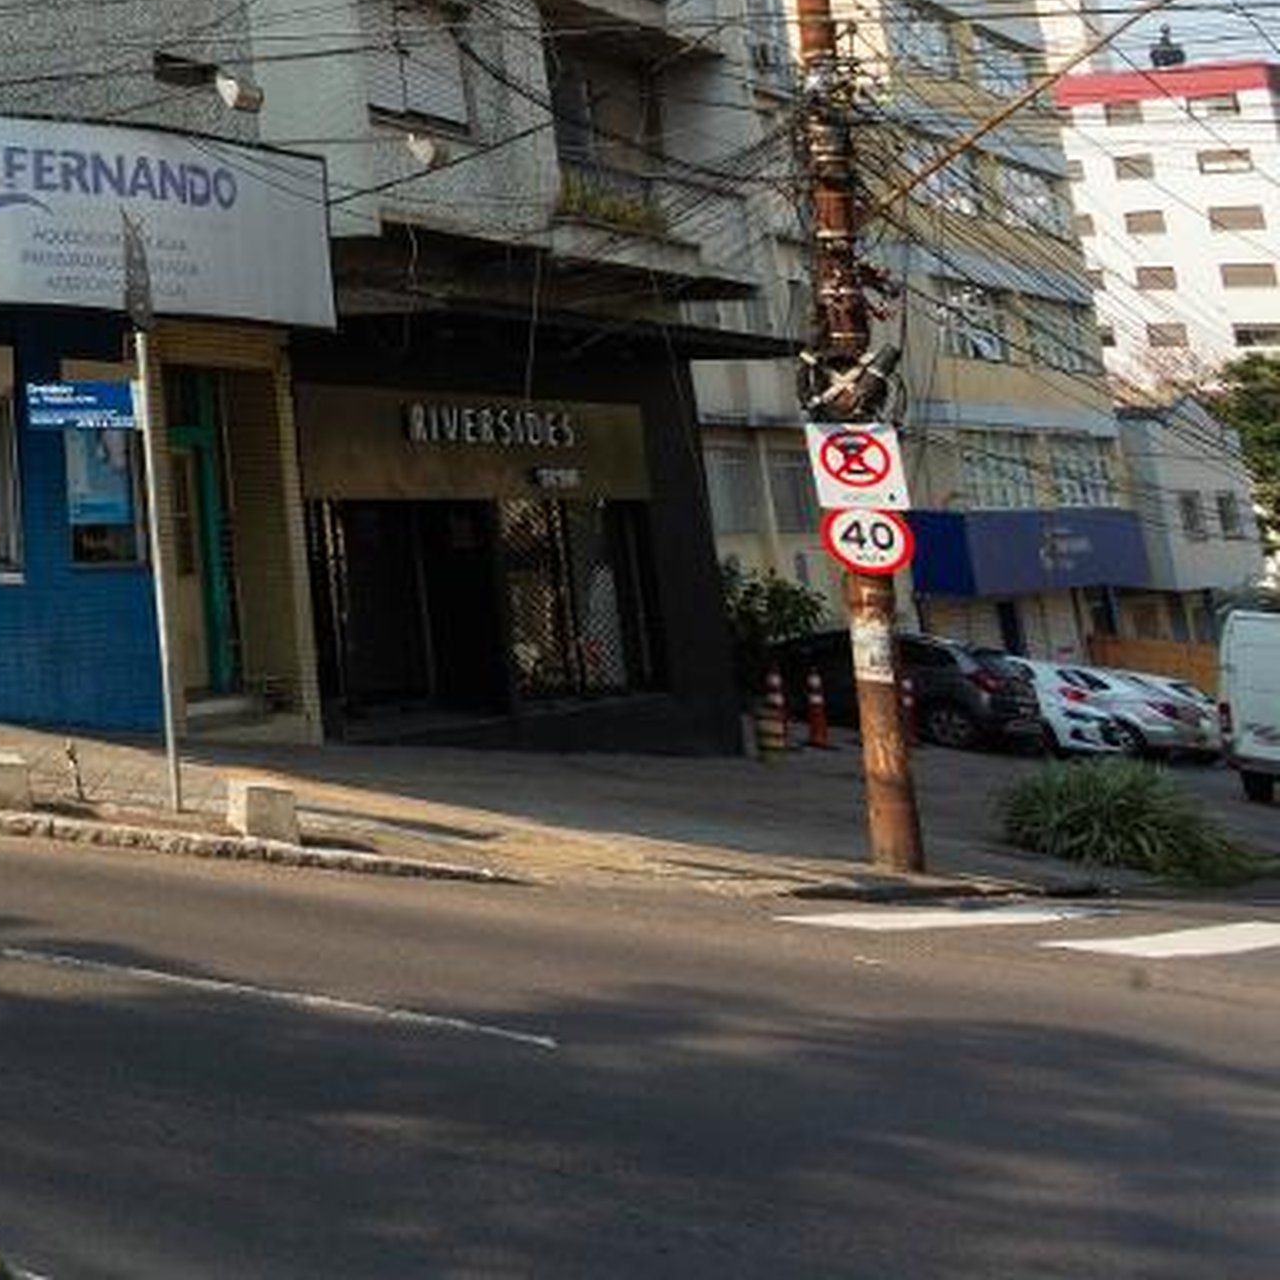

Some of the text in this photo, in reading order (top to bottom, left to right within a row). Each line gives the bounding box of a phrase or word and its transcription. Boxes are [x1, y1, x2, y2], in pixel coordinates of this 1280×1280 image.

[1, 145, 238, 210] FERNANDO
[409, 402, 575, 447] RIVERSIDES
[840, 520, 895, 552] 40
